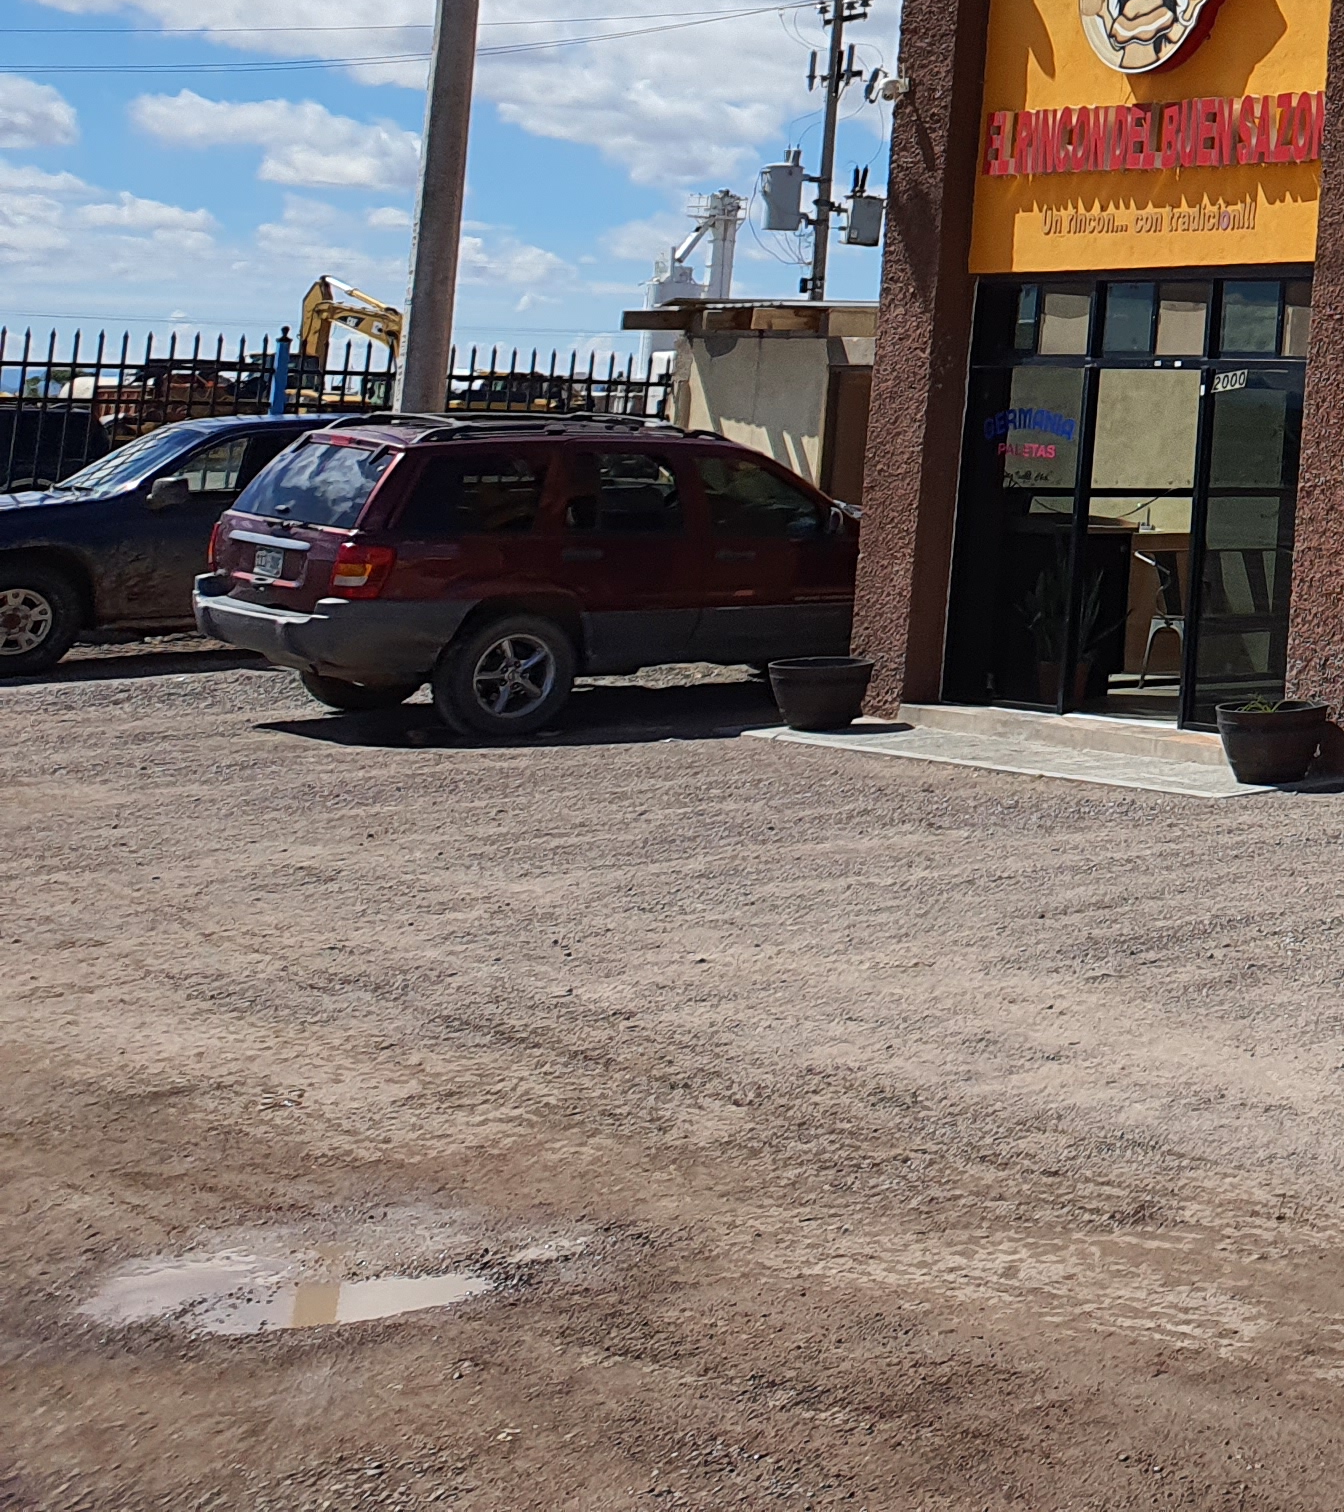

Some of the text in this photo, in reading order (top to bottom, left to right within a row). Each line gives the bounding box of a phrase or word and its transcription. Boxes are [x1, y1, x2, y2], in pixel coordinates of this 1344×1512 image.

[983, 111, 1015, 175] EL
[1015, 104, 1110, 175] RINCON
[1109, 101, 1161, 170] DEL
[1161, 97, 1236, 168] BUEN
[1043, 205, 1063, 236] Un
[1134, 211, 1163, 233] con
[1213, 371, 1246, 391] 2000
[984, 407, 1076, 441] GERMANIA
[997, 442, 1057, 459] PALETAS
